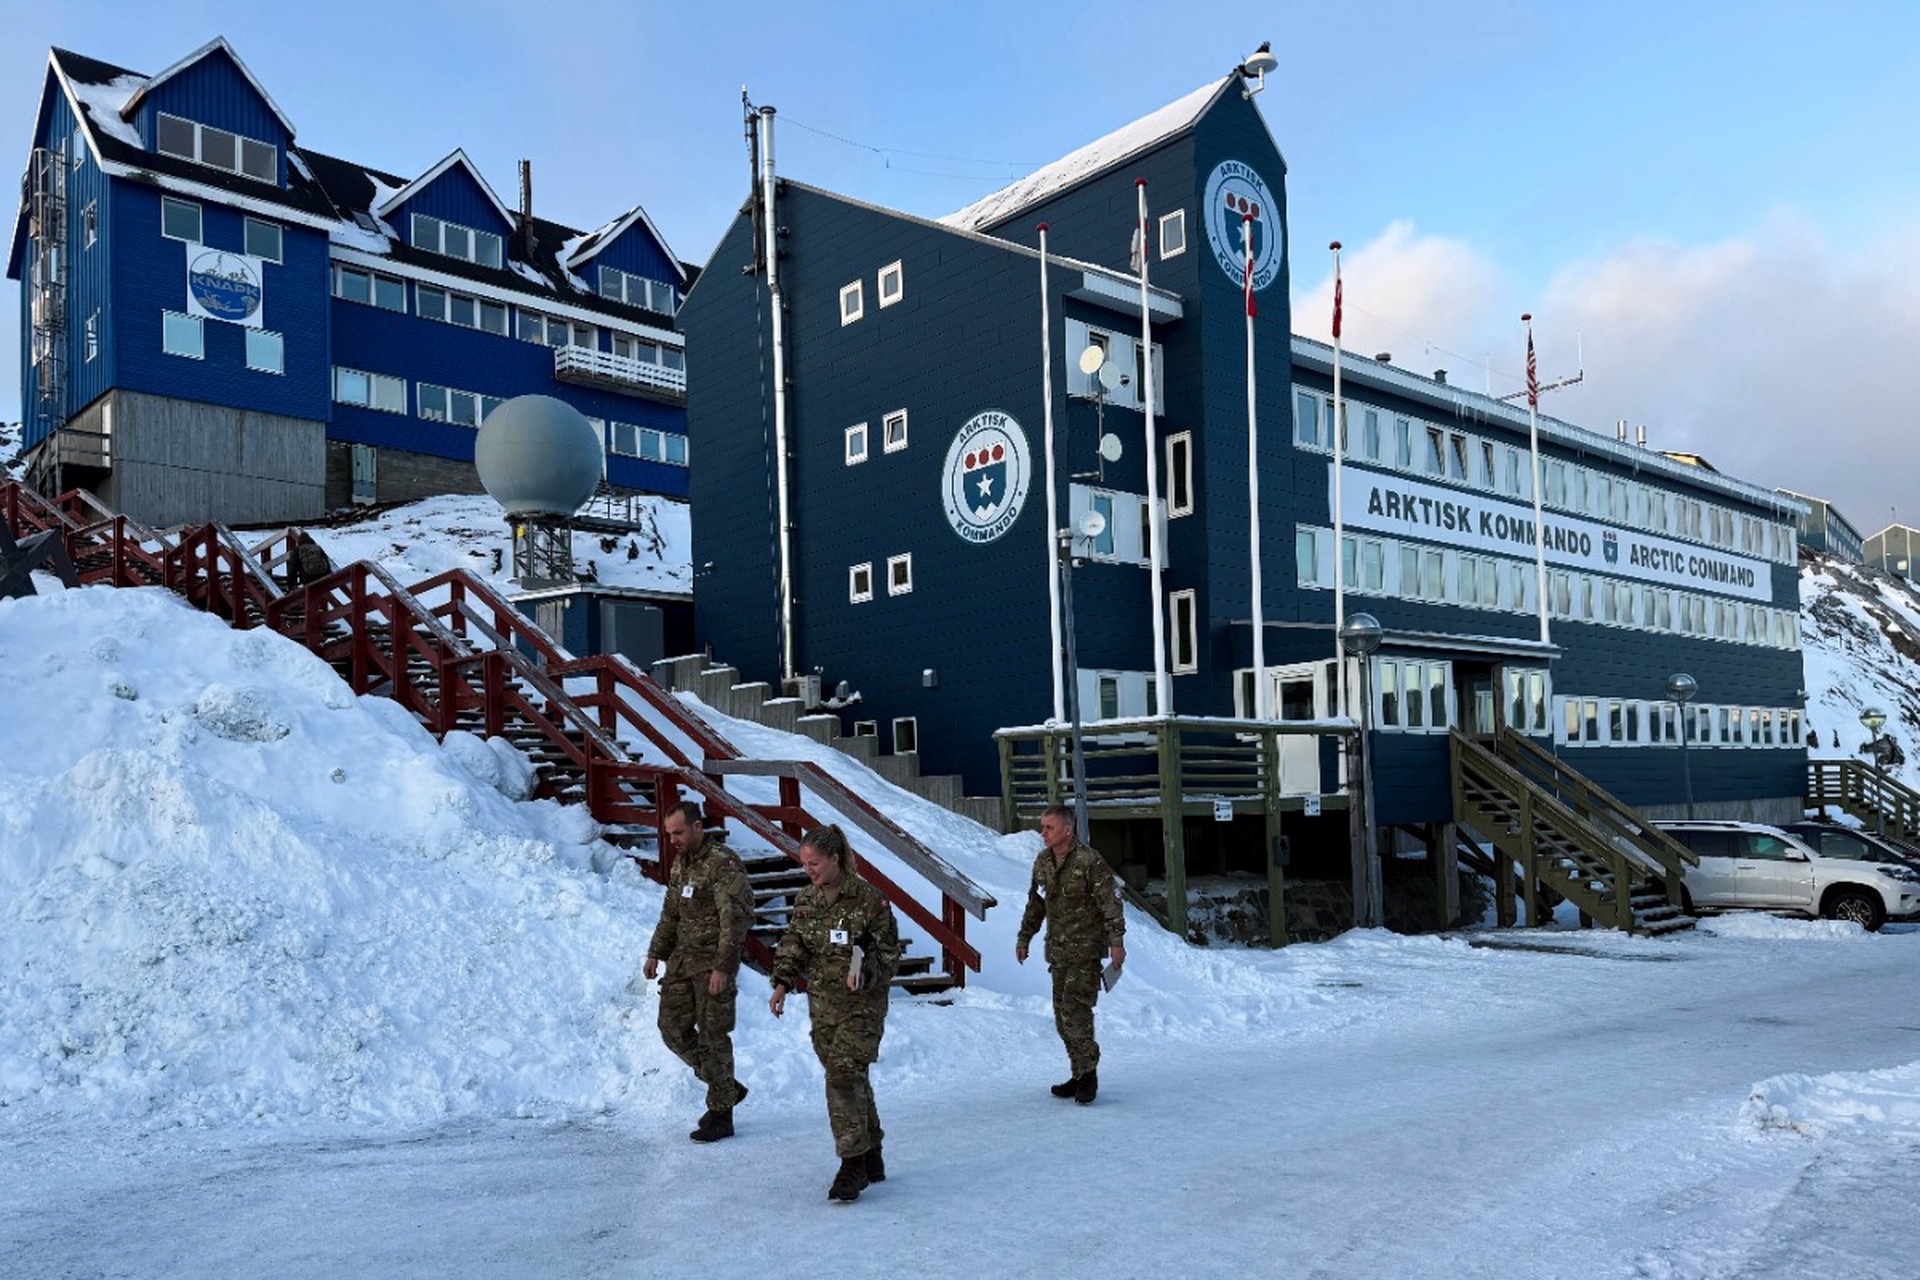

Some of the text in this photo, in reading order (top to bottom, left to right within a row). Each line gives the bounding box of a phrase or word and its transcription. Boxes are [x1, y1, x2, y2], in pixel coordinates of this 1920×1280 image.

[1220, 165, 1263, 192] ARKTISK
[959, 414, 1008, 443] ARKTISK
[955, 506, 1017, 541] KOMMANDO
[1368, 486, 1473, 533] ARKTISK
[1630, 544, 1685, 574] ARCTIC
[1690, 556, 1754, 587] COMMAND
